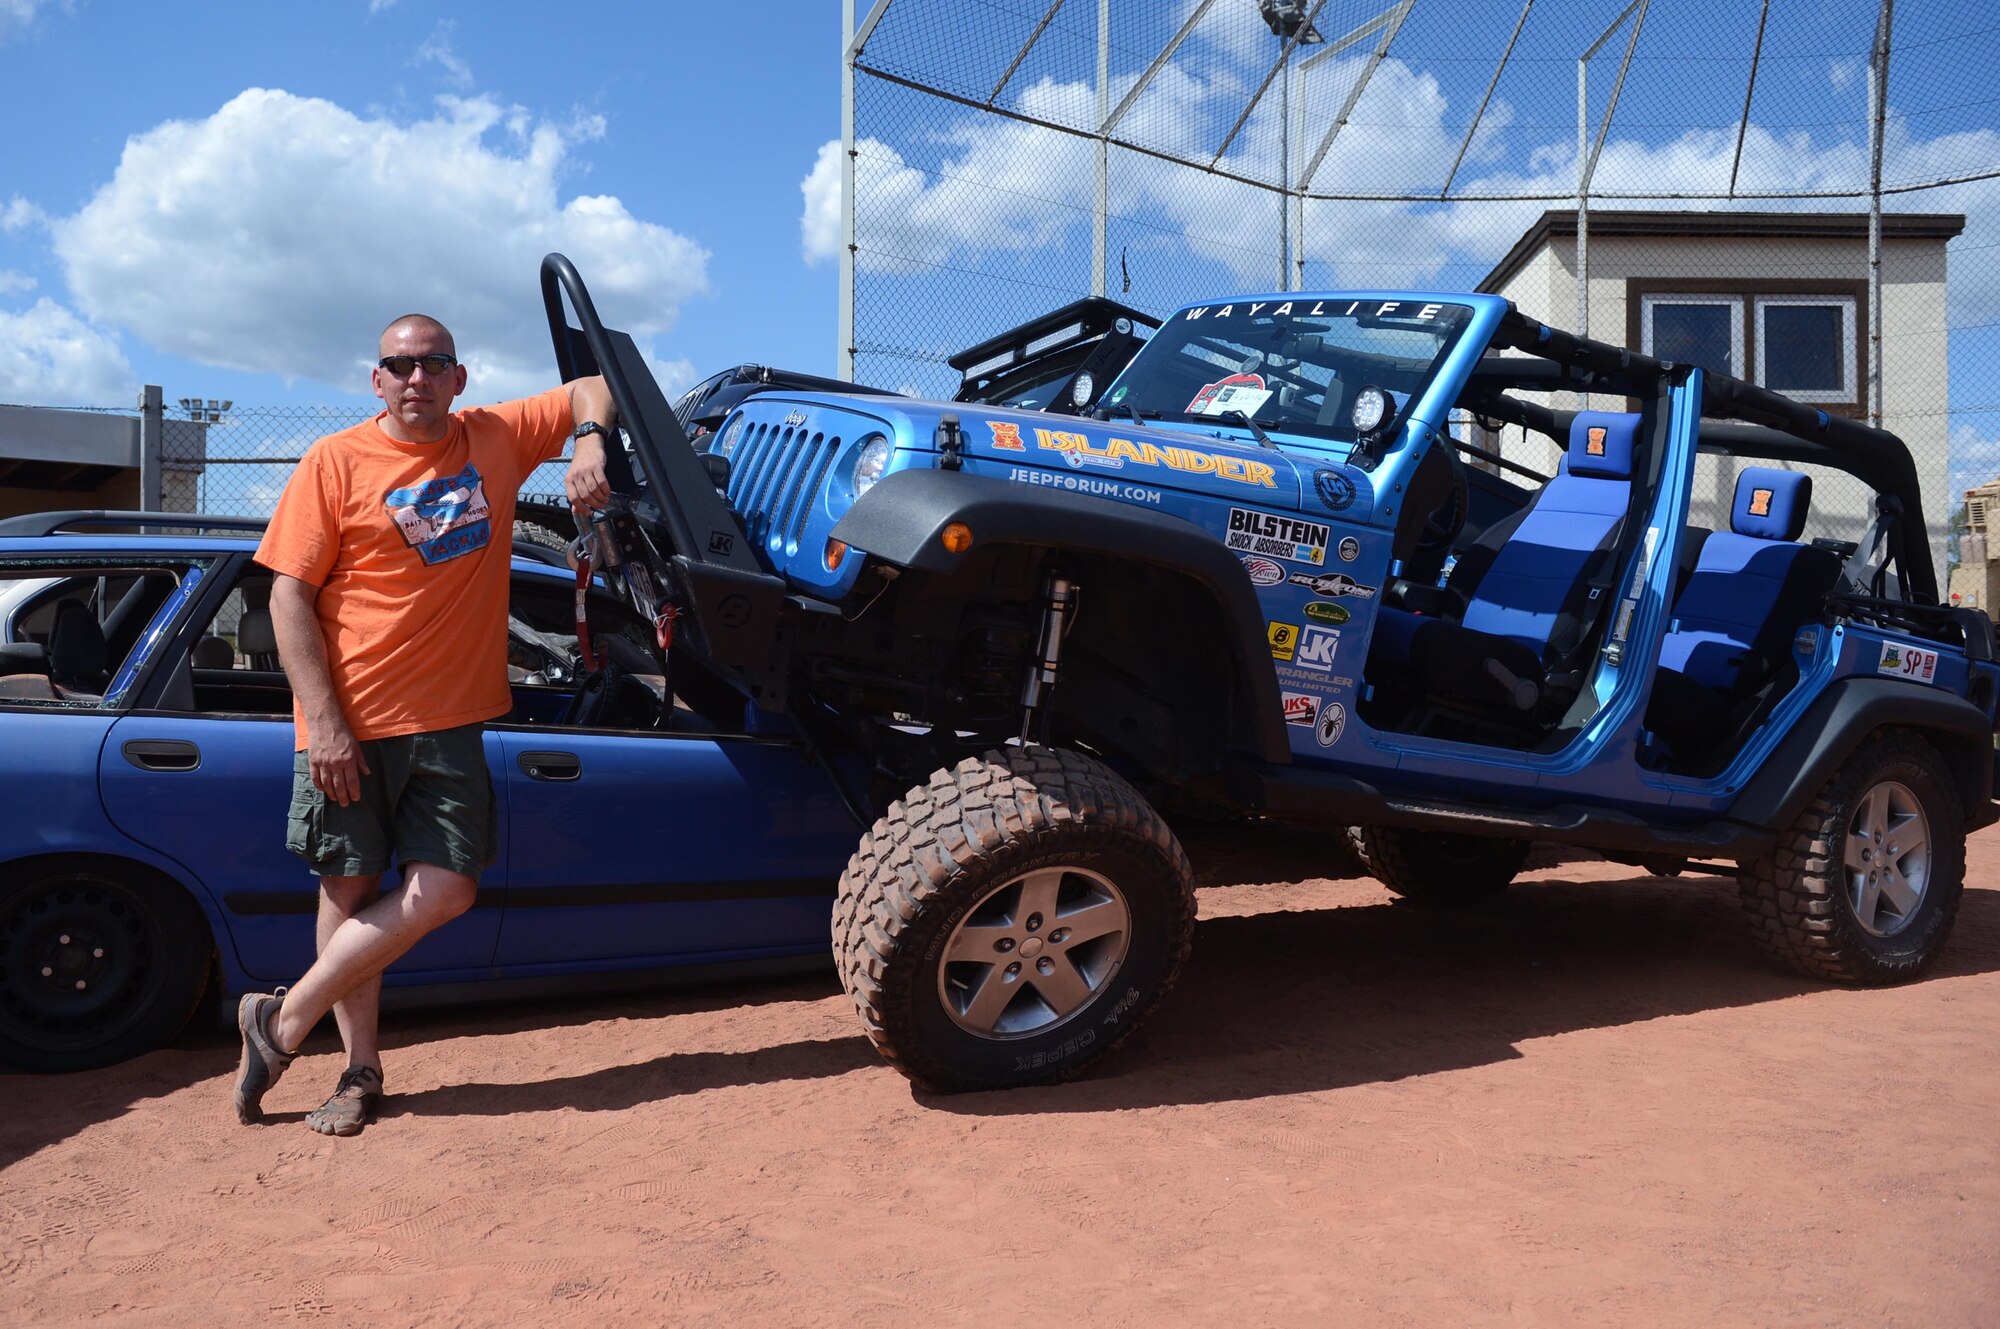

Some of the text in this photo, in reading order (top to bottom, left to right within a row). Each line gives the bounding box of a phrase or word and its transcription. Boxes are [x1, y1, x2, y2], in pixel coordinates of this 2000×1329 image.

[1033, 428, 1279, 489] ISLANDER
[1009, 467, 1161, 504] JEEPFORUM.COM
[1228, 532, 1254, 550] SHOCK
[1253, 537, 1296, 558] ABSORBERS
[1229, 509, 1328, 548] BILSTEIN
[1300, 634, 1337, 664] JK
[1903, 649, 1922, 675] SP
[1279, 679, 1342, 694] UNLIMITED
[1014, 987, 1140, 1072] Dick CEPEK
